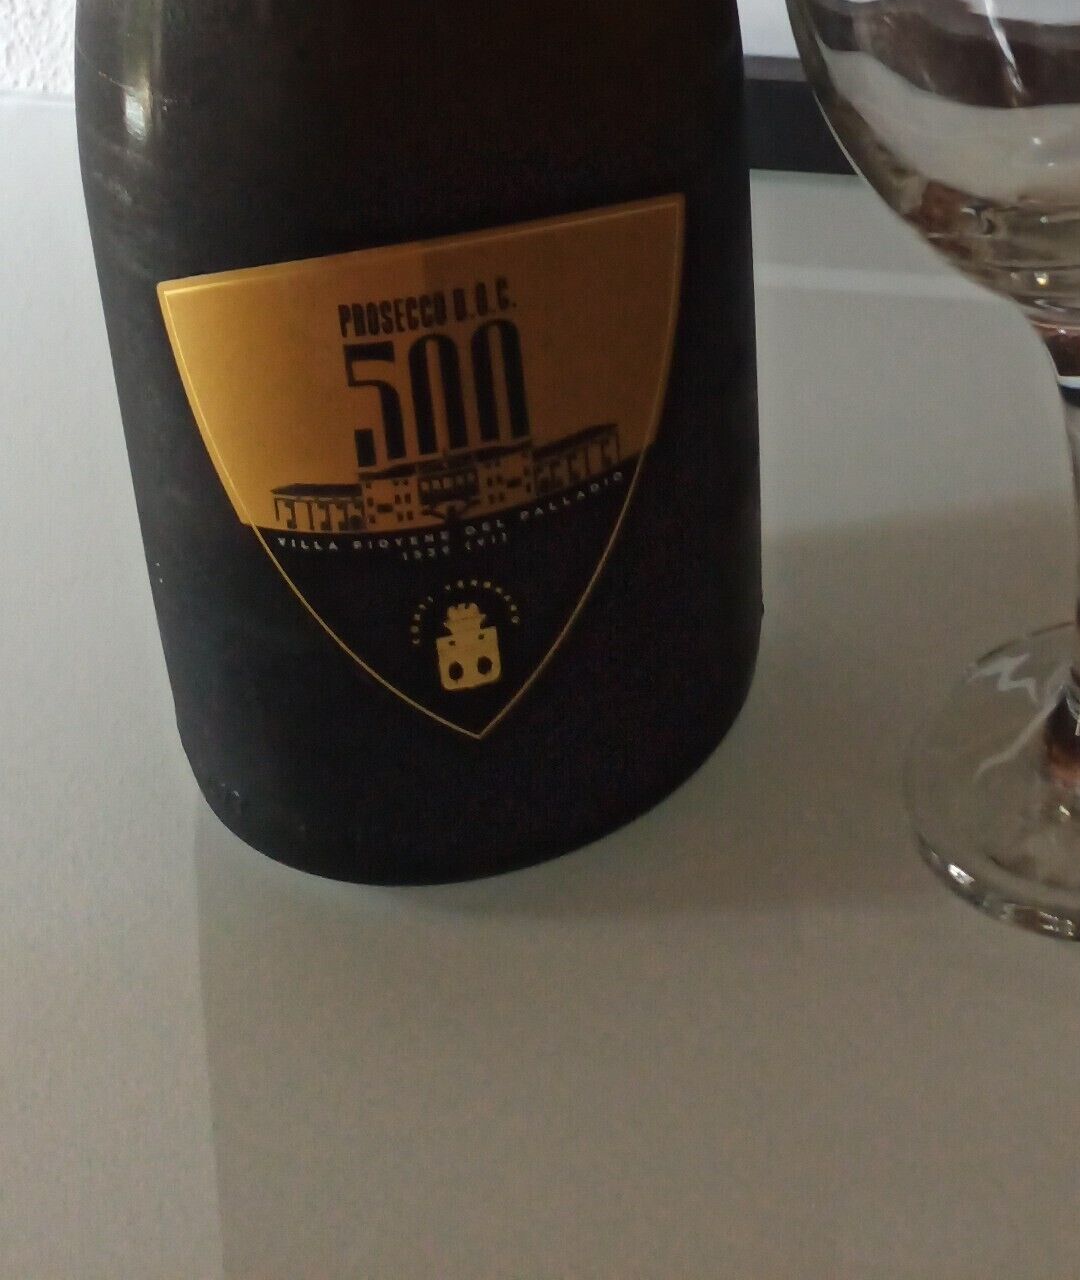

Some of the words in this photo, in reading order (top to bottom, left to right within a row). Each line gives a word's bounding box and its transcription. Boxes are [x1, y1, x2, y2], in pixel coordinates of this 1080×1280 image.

[338, 289, 448, 338] PROSECCO
[343, 317, 533, 468] 500
[277, 536, 339, 551] VILLA
